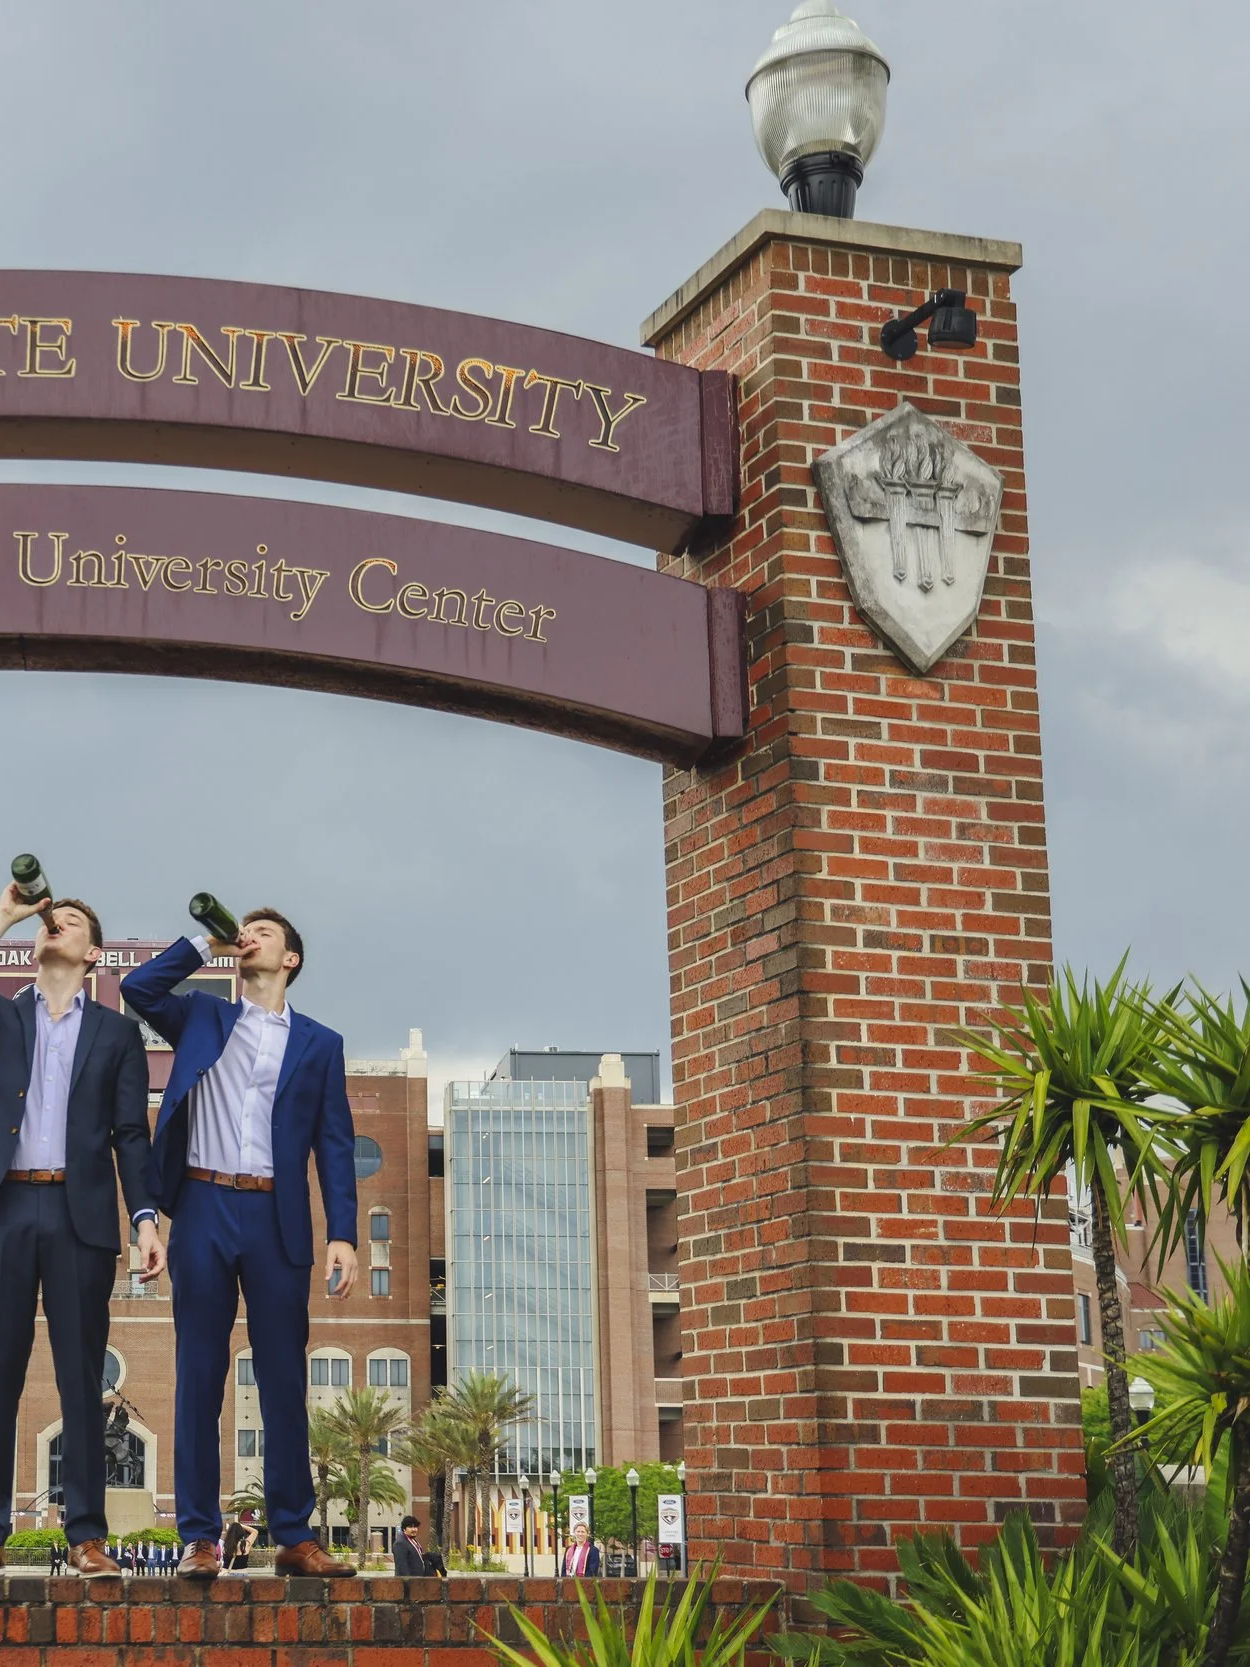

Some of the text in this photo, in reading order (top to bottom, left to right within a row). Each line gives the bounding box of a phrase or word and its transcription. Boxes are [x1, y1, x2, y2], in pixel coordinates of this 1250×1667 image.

[112, 316, 646, 452] UNIVERSITY
[13, 530, 330, 621] University
[348, 557, 556, 642] Center
